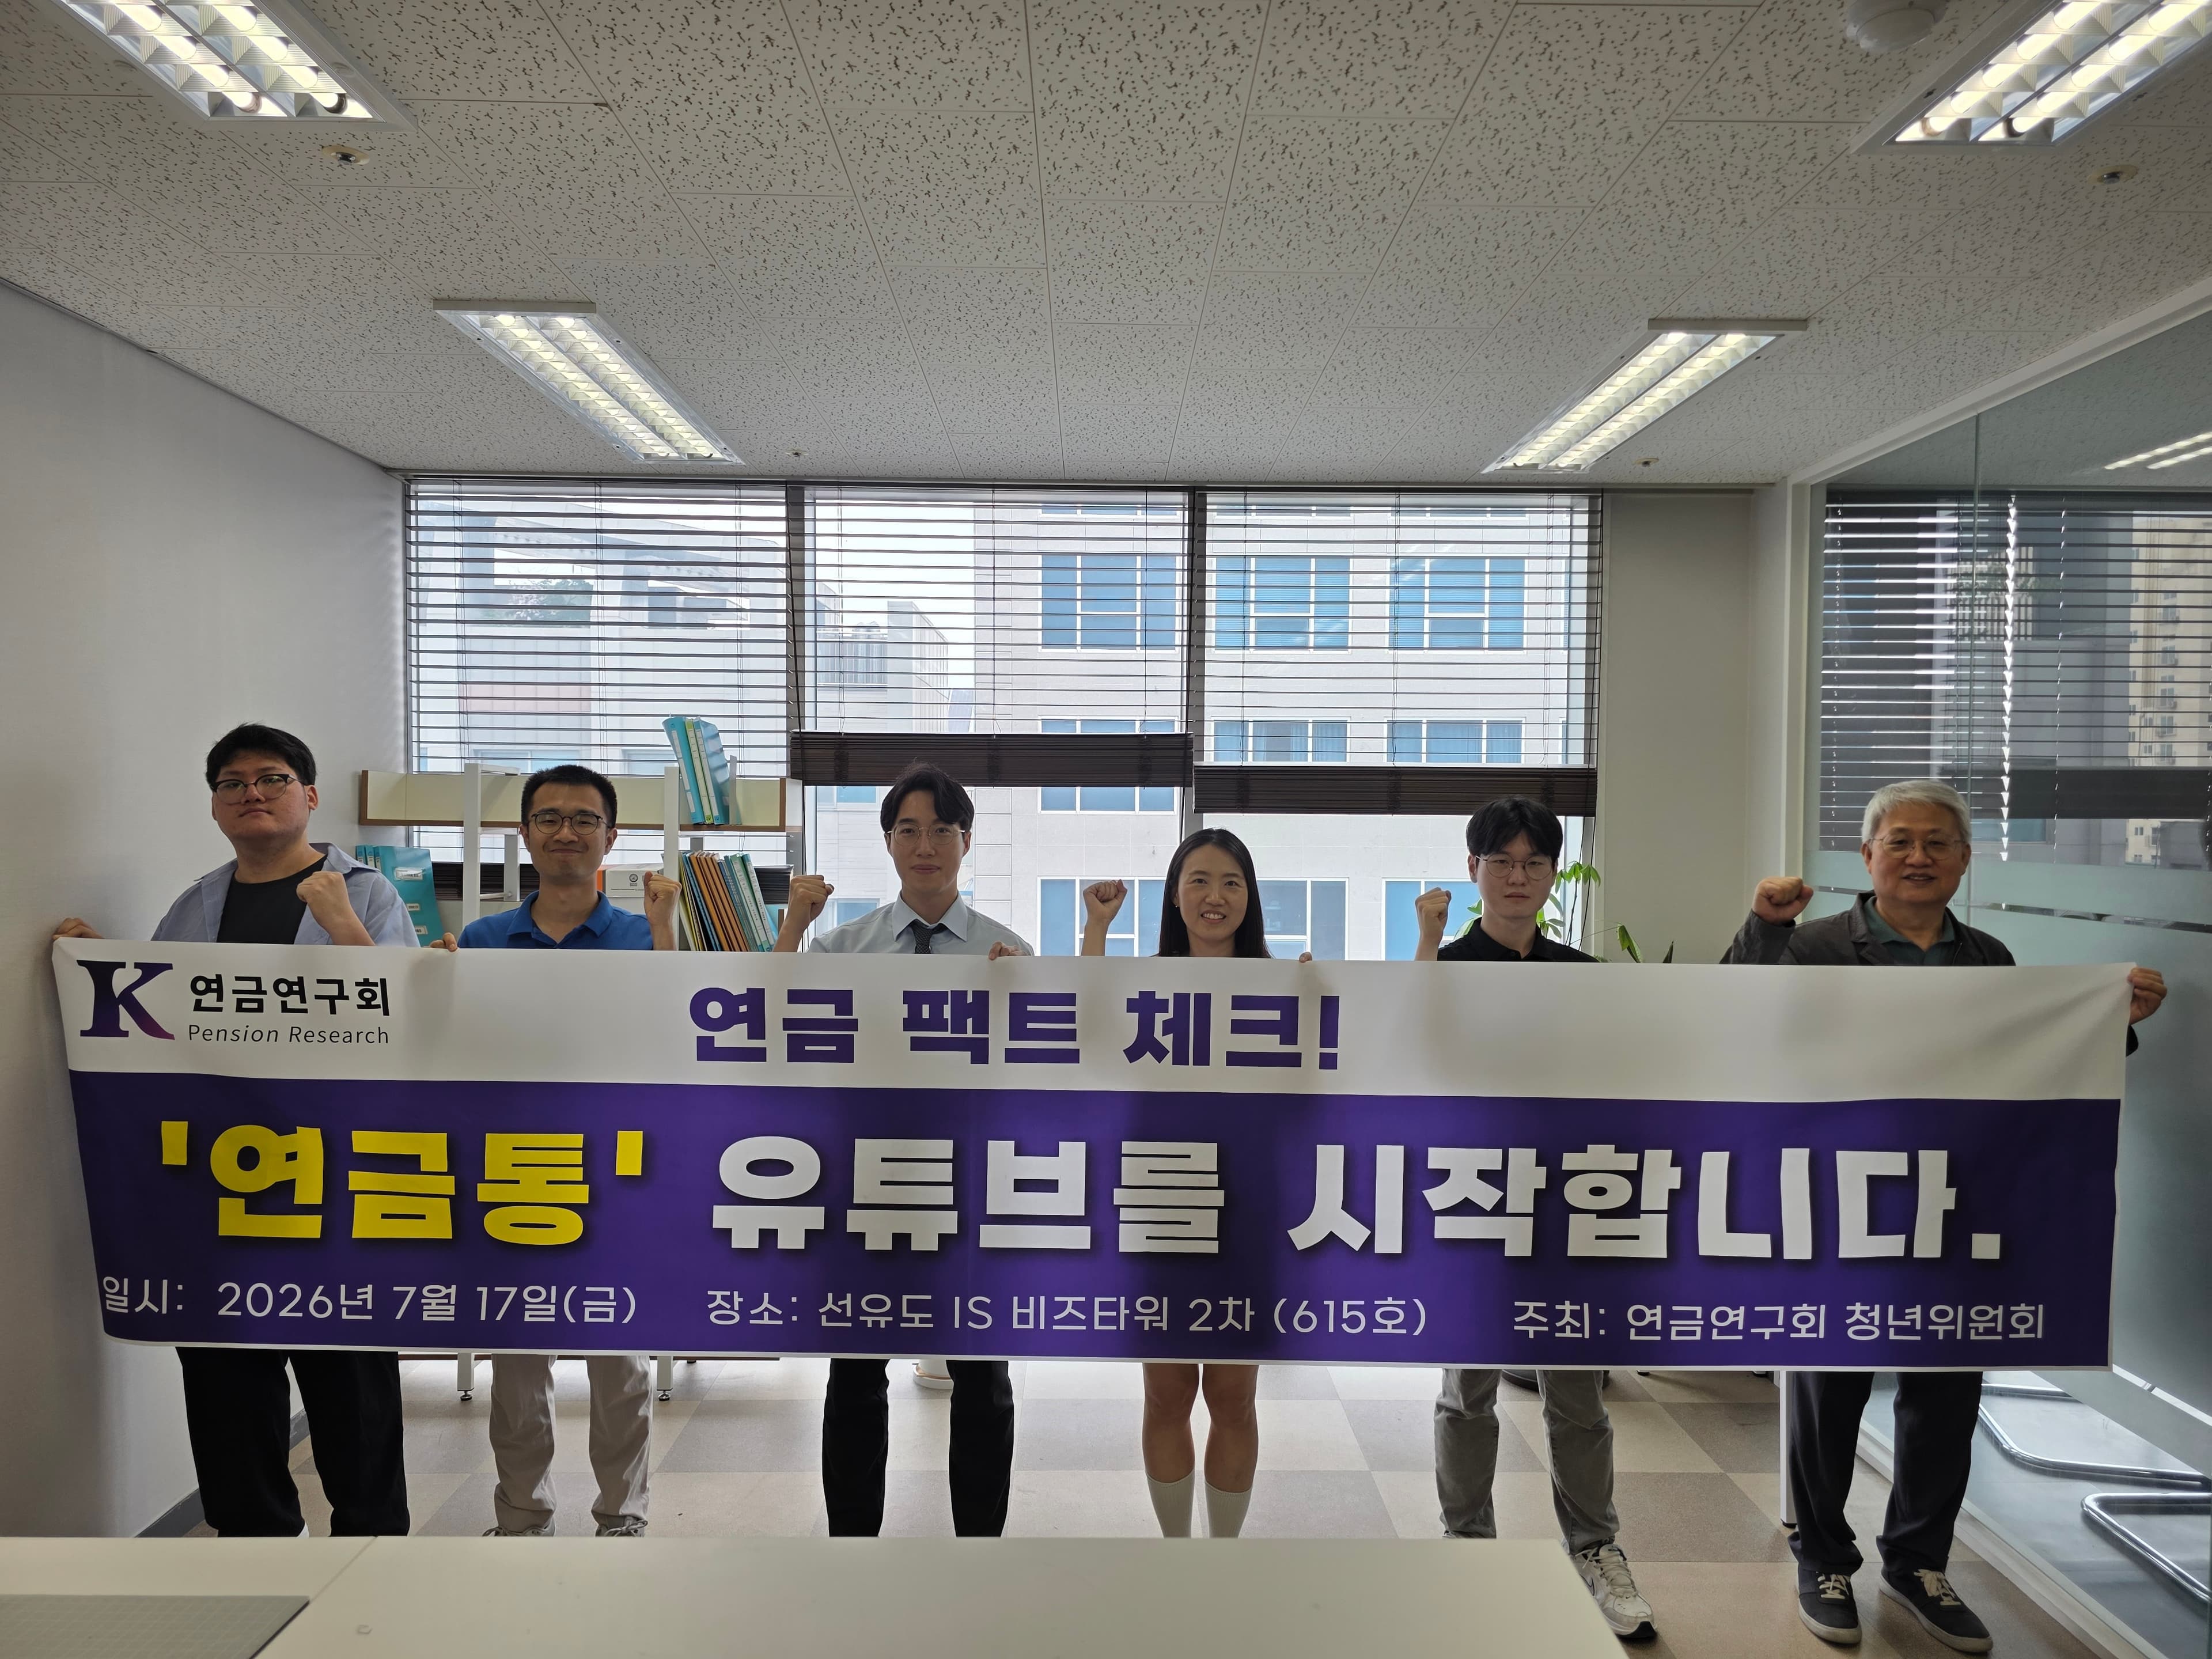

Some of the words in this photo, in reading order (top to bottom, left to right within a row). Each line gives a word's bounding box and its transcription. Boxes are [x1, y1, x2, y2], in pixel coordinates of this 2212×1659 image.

[76, 959, 175, 1040] K
[190, 974, 390, 1016] 연금연구회
[189, 1024, 278, 1043] Pension
[289, 1026, 388, 1044] Research
[690, 987, 859, 1063] 연금
[903, 990, 1080, 1065] 팩트
[1123, 990, 1340, 1070] 체크!
[161, 1120, 643, 1245] '연금통'
[712, 1135, 1225, 1253] 유튜브를
[1287, 1144, 2001, 1260] 시작합니다.
[101, 1276, 183, 1314] 일시:
[218, 1282, 373, 1320] 2026년
[393, 1285, 457, 1321] 7월
[476, 1285, 635, 1324] 17일(금)
[707, 1290, 797, 1325] 장소:
[818, 1293, 934, 1328] 선유도
[954, 1296, 993, 1330] IS
[1013, 1296, 1168, 1331] 비즈타워
[1188, 1297, 1255, 1332] 2차
[1274, 1297, 1426, 1336] (615호)
[1513, 1300, 1605, 1339] 주최:
[1627, 1303, 1825, 1340] 연금연구회
[1845, 1302, 2043, 1340] 청년위원회
